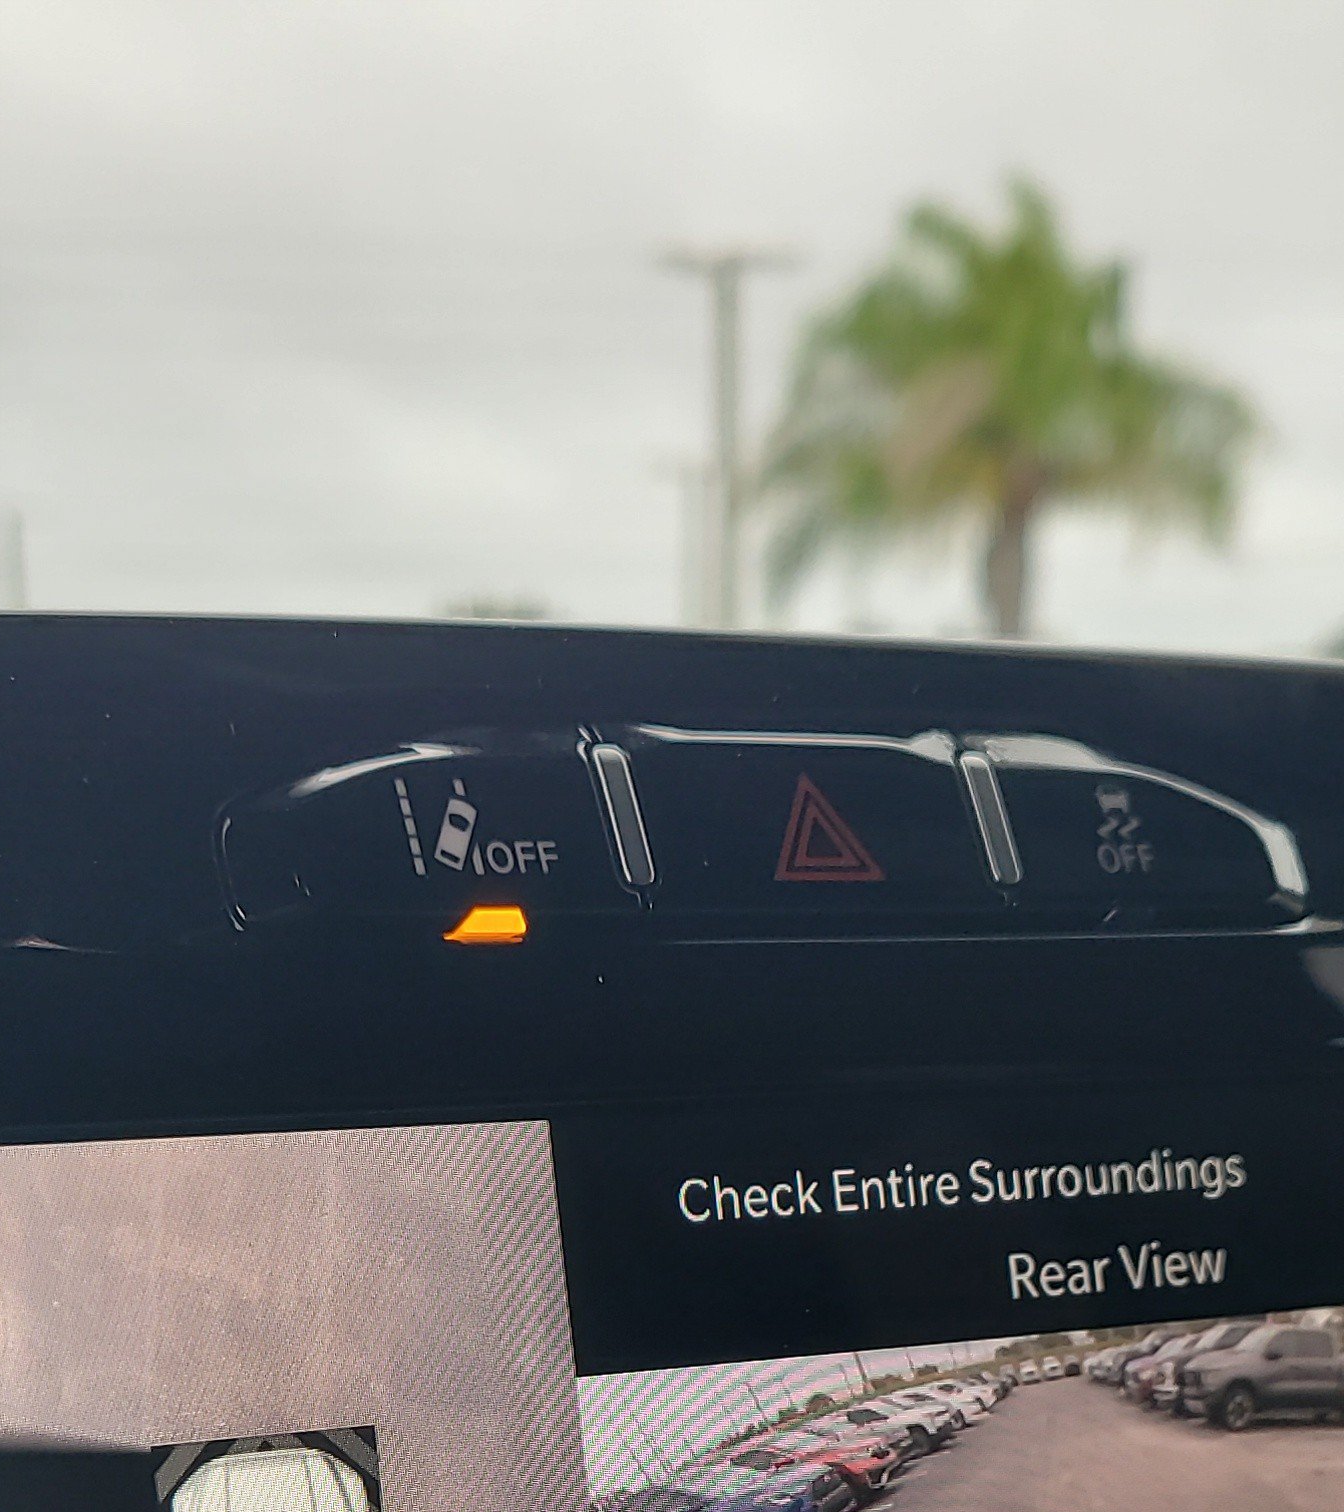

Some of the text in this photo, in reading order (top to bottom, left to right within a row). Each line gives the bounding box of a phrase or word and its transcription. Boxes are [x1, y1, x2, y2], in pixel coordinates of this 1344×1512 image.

[485, 840, 559, 876] OFF
[1096, 842, 1155, 874] OFF
[677, 1147, 1248, 1223] Check Entire Surroundings
[1007, 1240, 1229, 1301] Rear View
